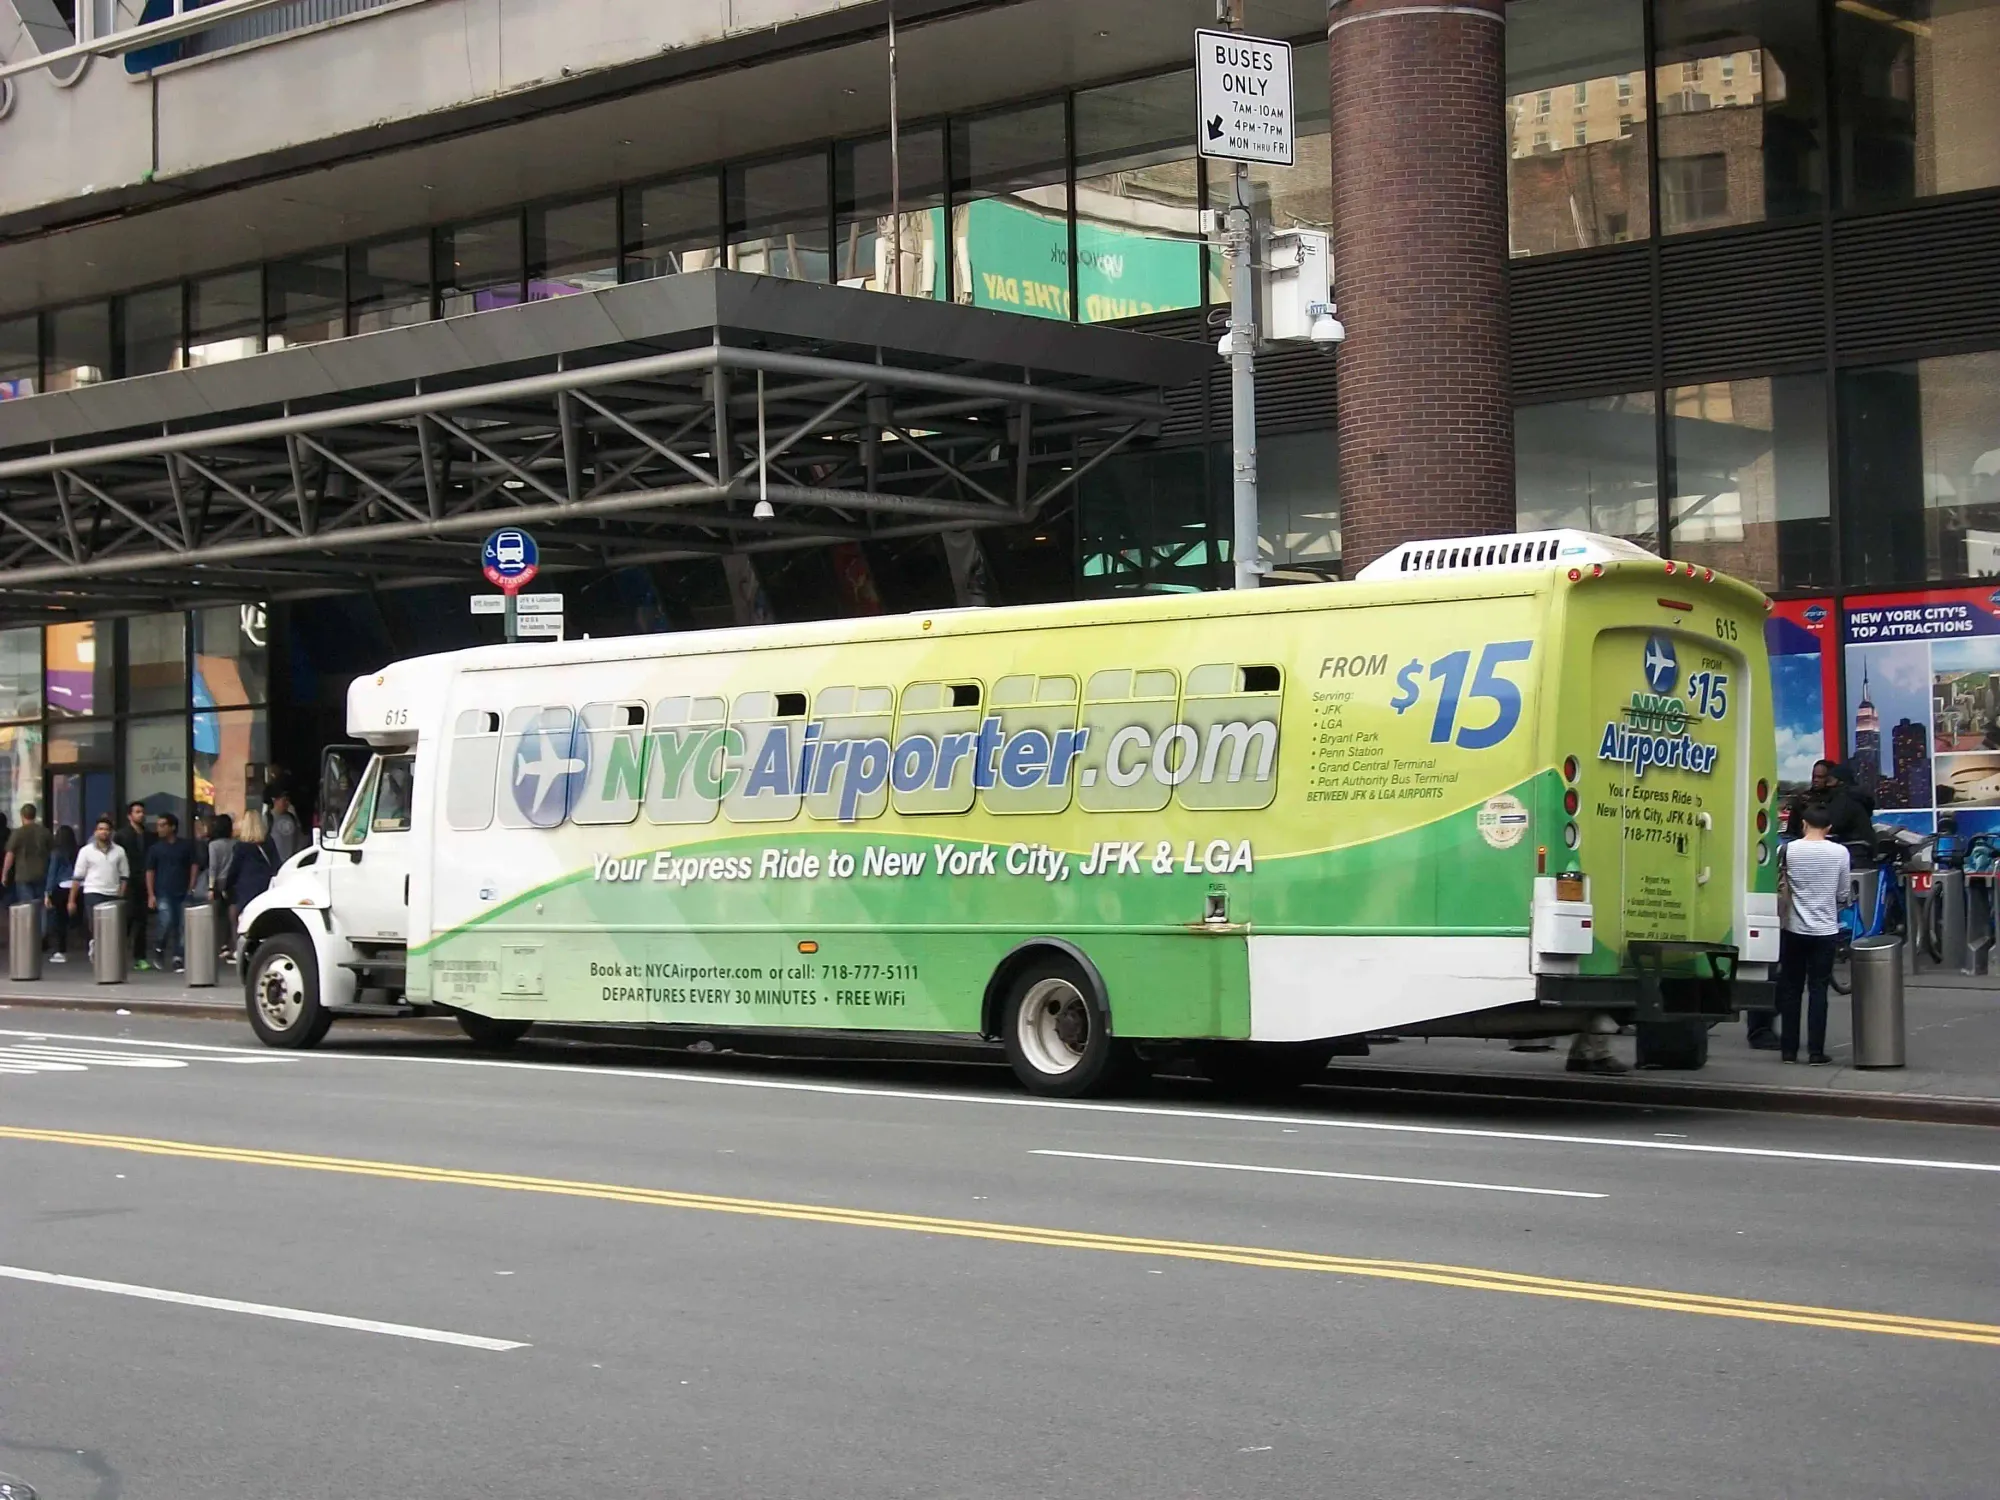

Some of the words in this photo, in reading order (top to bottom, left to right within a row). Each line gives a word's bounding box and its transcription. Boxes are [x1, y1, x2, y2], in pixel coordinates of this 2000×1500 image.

[1216, 45, 1273, 71] BUSES
[1222, 73, 1268, 96] ONLY
[1229, 136, 1249, 150] MON
[1253, 142, 1270, 152] THRU
[1273, 141, 1288, 154] FRI
[1851, 612, 1882, 624] NEW
[1885, 609, 1922, 622] YORK
[1924, 606, 1968, 620] CITY'S
[1716, 617, 1738, 642] 615
[1851, 626, 1878, 638] TOP
[1880, 620, 1973, 637] ATTRACTIONS
[1319, 653, 1388, 679] FROM
[1701, 657, 1723, 671] FROM
[1312, 690, 1354, 702] Serving:
[1390, 639, 1534, 750] $15
[1688, 671, 1729, 720] $15
[385, 709, 408, 726] 615
[1322, 704, 1343, 715] JFK
[1630, 691, 1686, 734] NYC
[1320, 719, 1343, 729] LGA
[1319, 733, 1353, 745] Bryant
[1355, 731, 1379, 742] Park
[1319, 747, 1345, 758] Penn
[1348, 746, 1384, 757] Station
[1597, 721, 1717, 777] Airporter
[1318, 761, 1349, 773] Grand
[1352, 760, 1390, 771] Central
[1393, 758, 1437, 771] Terminal
[1317, 776, 1339, 787] Port
[1343, 775, 1388, 787] Authority
[1391, 774, 1411, 785] Bus
[1414, 772, 1459, 784] Terminal
[1307, 790, 1349, 802] BETWEEN
[1350, 789, 1366, 801] JFK
[1369, 789, 1375, 800] &
[1378, 788, 1396, 800] LGA
[1398, 787, 1444, 799] AIRPORTS
[1609, 783, 1630, 798] Your
[1632, 785, 1669, 802] Express
[1672, 790, 1692, 805] Ride
[1597, 803, 1618, 817] New
[1621, 805, 1641, 819] York
[1644, 807, 1663, 824] City,
[1666, 810, 1684, 824] JFK
[1687, 812, 1693, 825] &
[592, 852, 647, 882] Your
[652, 850, 751, 886] Express
[759, 848, 820, 880] Ride
[828, 849, 855, 879] to
[862, 846, 926, 877] New
[933, 843, 998, 876] York
[1005, 842, 1071, 882] City,
[1079, 841, 1145, 876] JFK
[1152, 840, 1174, 875] &
[1183, 840, 1254, 875] LGA
[1209, 883, 1227, 891] FUEL
[590, 962, 622, 977] Book
[625, 963, 642, 978] at:
[645, 963, 763, 982] NYCAirporter.com
[769, 967, 784, 981] or
[787, 964, 816, 981] call:
[822, 965, 919, 981] 718-777-5111
[602, 987, 687, 1004] DEPARTURES
[690, 988, 732, 1004] EVERY
[735, 989, 752, 1005] 30
[755, 990, 817, 1006] MINUTES
[836, 991, 871, 1007] FREE
[875, 990, 906, 1007] WiFi
